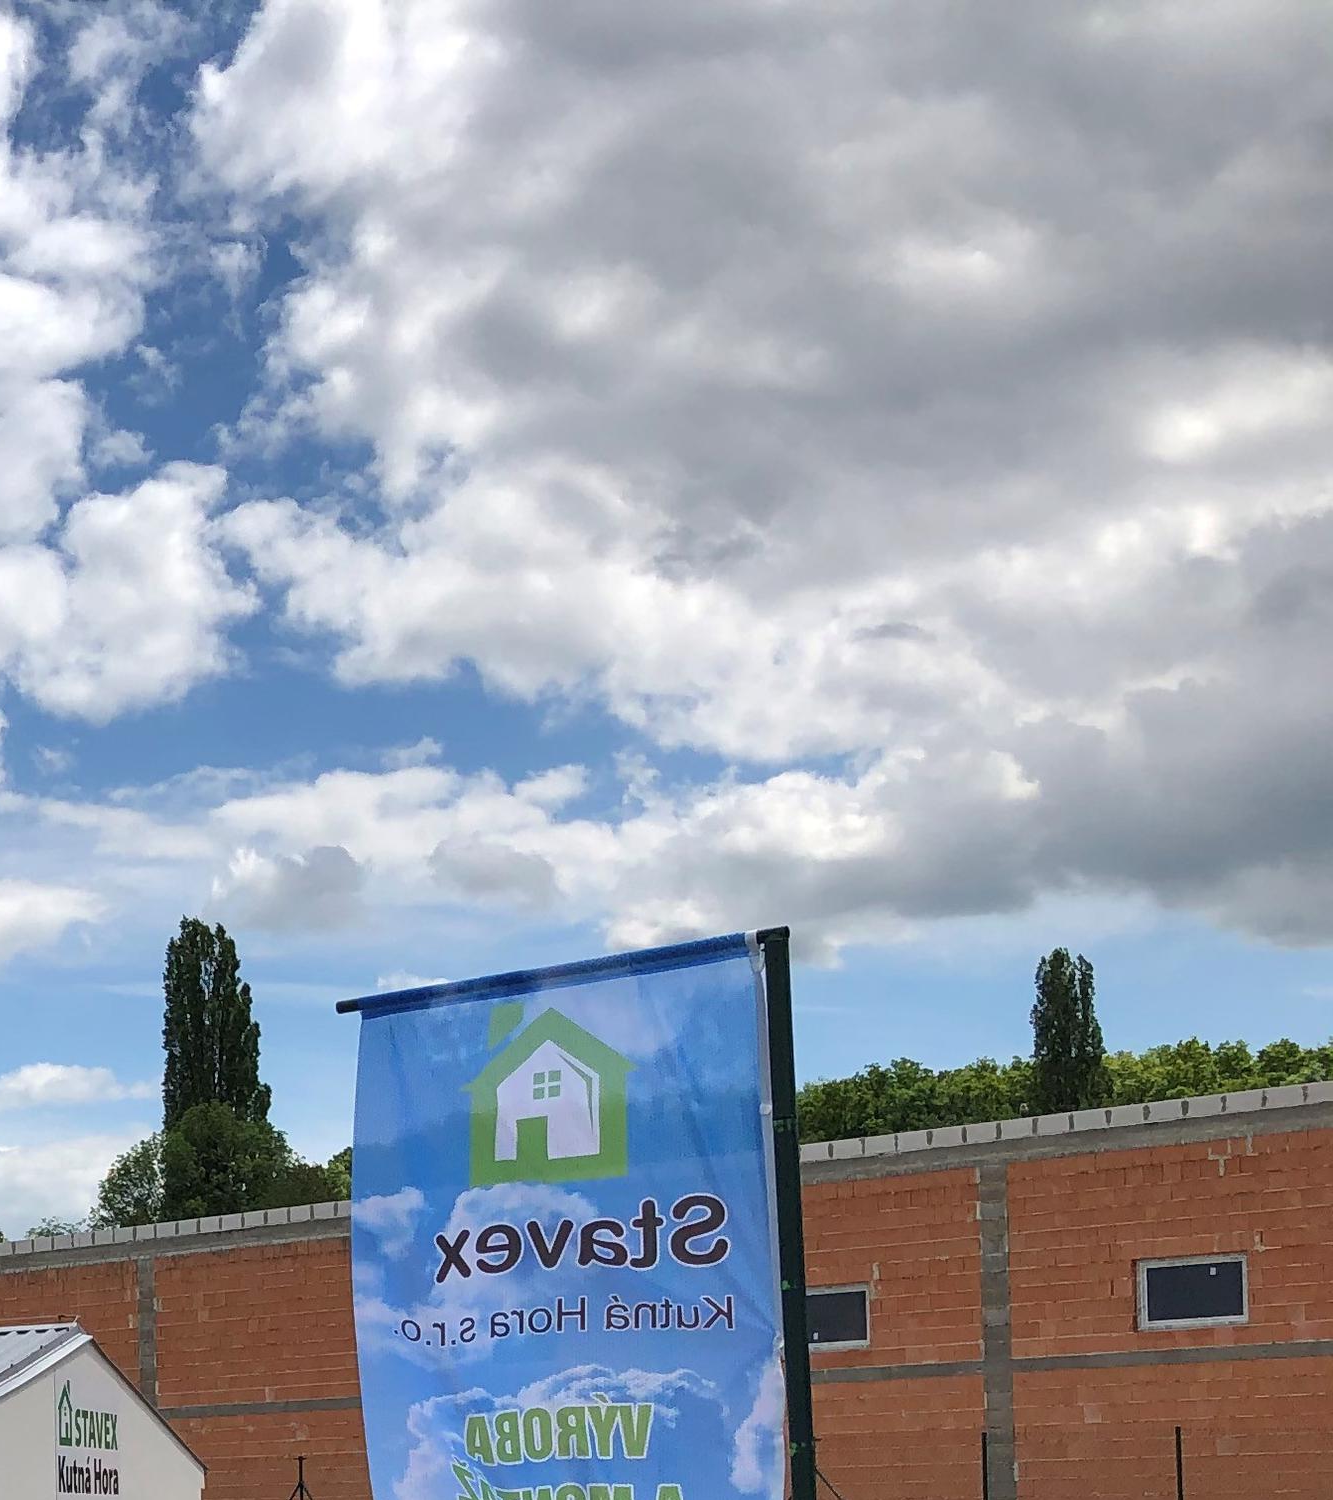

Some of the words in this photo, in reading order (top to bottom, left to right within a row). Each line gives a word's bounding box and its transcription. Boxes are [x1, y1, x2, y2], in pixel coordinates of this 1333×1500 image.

[74, 1408, 118, 1450] STAVEX
[58, 1455, 91, 1494] Kutná
[94, 1458, 119, 1495] Hora
